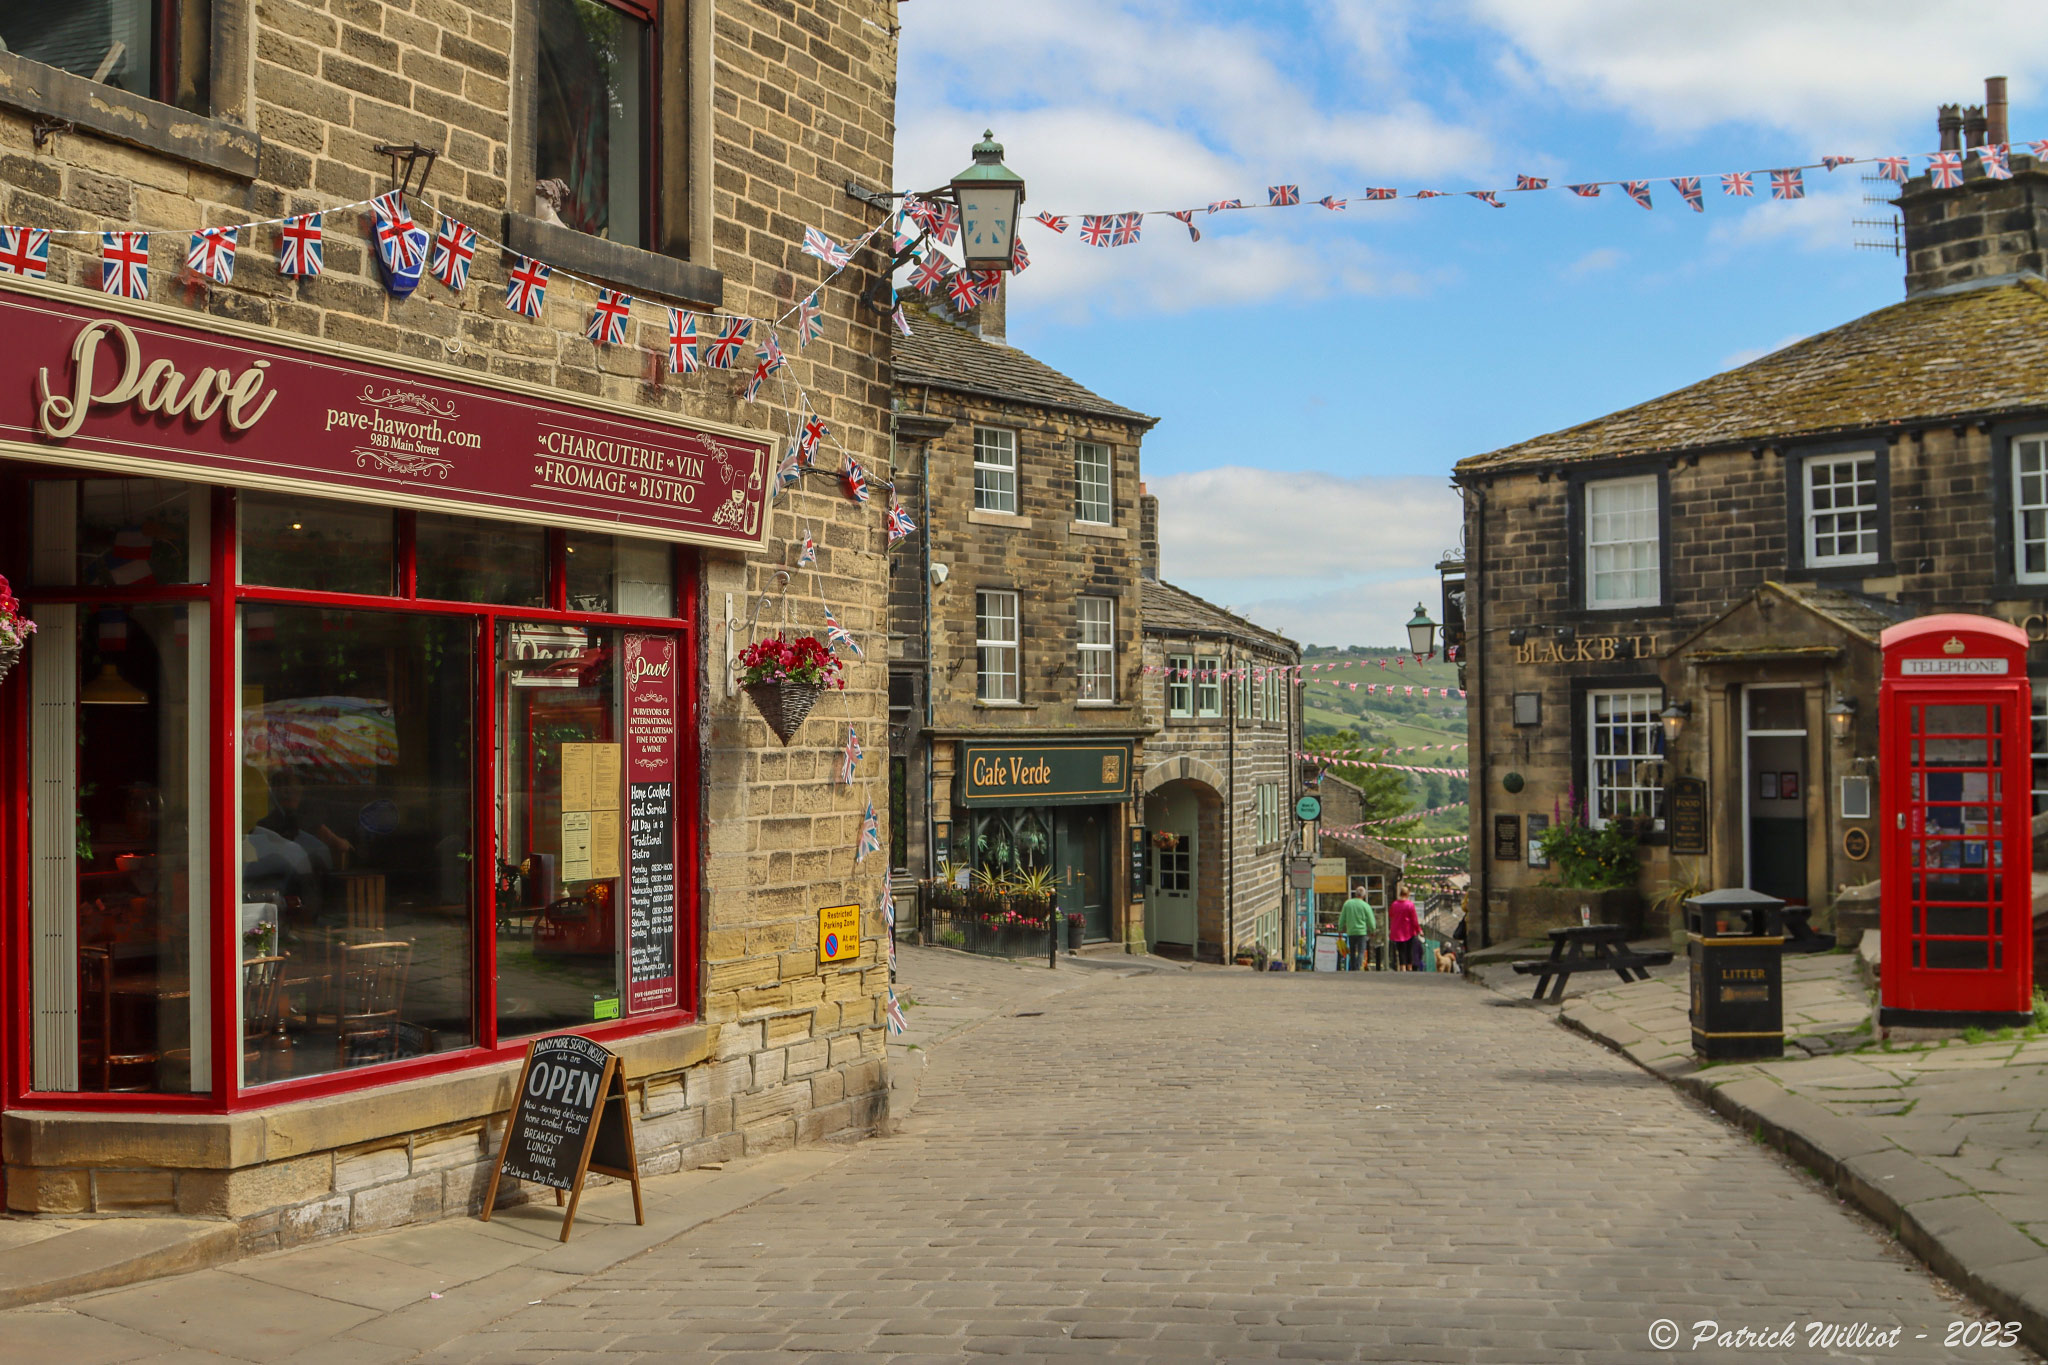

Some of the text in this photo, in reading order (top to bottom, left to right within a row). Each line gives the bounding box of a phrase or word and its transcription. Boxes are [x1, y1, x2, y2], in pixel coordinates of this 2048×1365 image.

[40, 319, 277, 438] Pavé
[325, 408, 482, 448] pave-haworth.com
[370, 433, 439, 456] 98B Main Street
[547, 432, 704, 478] CHARCUTERIE VIN
[544, 461, 695, 504] FROMAGE BISTRO
[1515, 635, 1657, 664] BLACK BLL
[631, 656, 670, 683] Pavé
[1910, 661, 2000, 673] TELEPHONE
[633, 708, 670, 716] PURVEYORS OF
[631, 717, 672, 725] INTERNATIONAL
[649, 736, 667, 744] FOODS
[973, 756, 1051, 787] Cafe Verde
[648, 783, 670, 799] Cooked
[631, 801, 667, 817] Food Served
[631, 819, 664, 833] All Day in a
[631, 832, 661, 846] Traditional
[631, 848, 650, 860] Bistro
[632, 864, 647, 875] Monday
[632, 875, 648, 885] Tuesday
[631, 897, 650, 907] Thursday
[632, 908, 645, 920] Friday
[827, 910, 852, 919] Restricted
[632, 918, 650, 929] Saturday
[824, 919, 855, 930] Parking Zone
[631, 927, 647, 938] Sunday
[849, 934, 857, 943] any
[1722, 969, 1765, 979] LITTER
[534, 1037, 608, 1065] MANY MORE SEATS INSIDE
[529, 1062, 599, 1108] OPEN
[524, 1099, 589, 1123] Now serving delicious
[525, 1112, 581, 1135] home cooked food
[524, 1127, 563, 1145] BREAKFAST
[526, 1140, 553, 1154] LUNCH
[530, 1153, 556, 1168] DINNER
[511, 1165, 572, 1191] We are Dog Friendly
